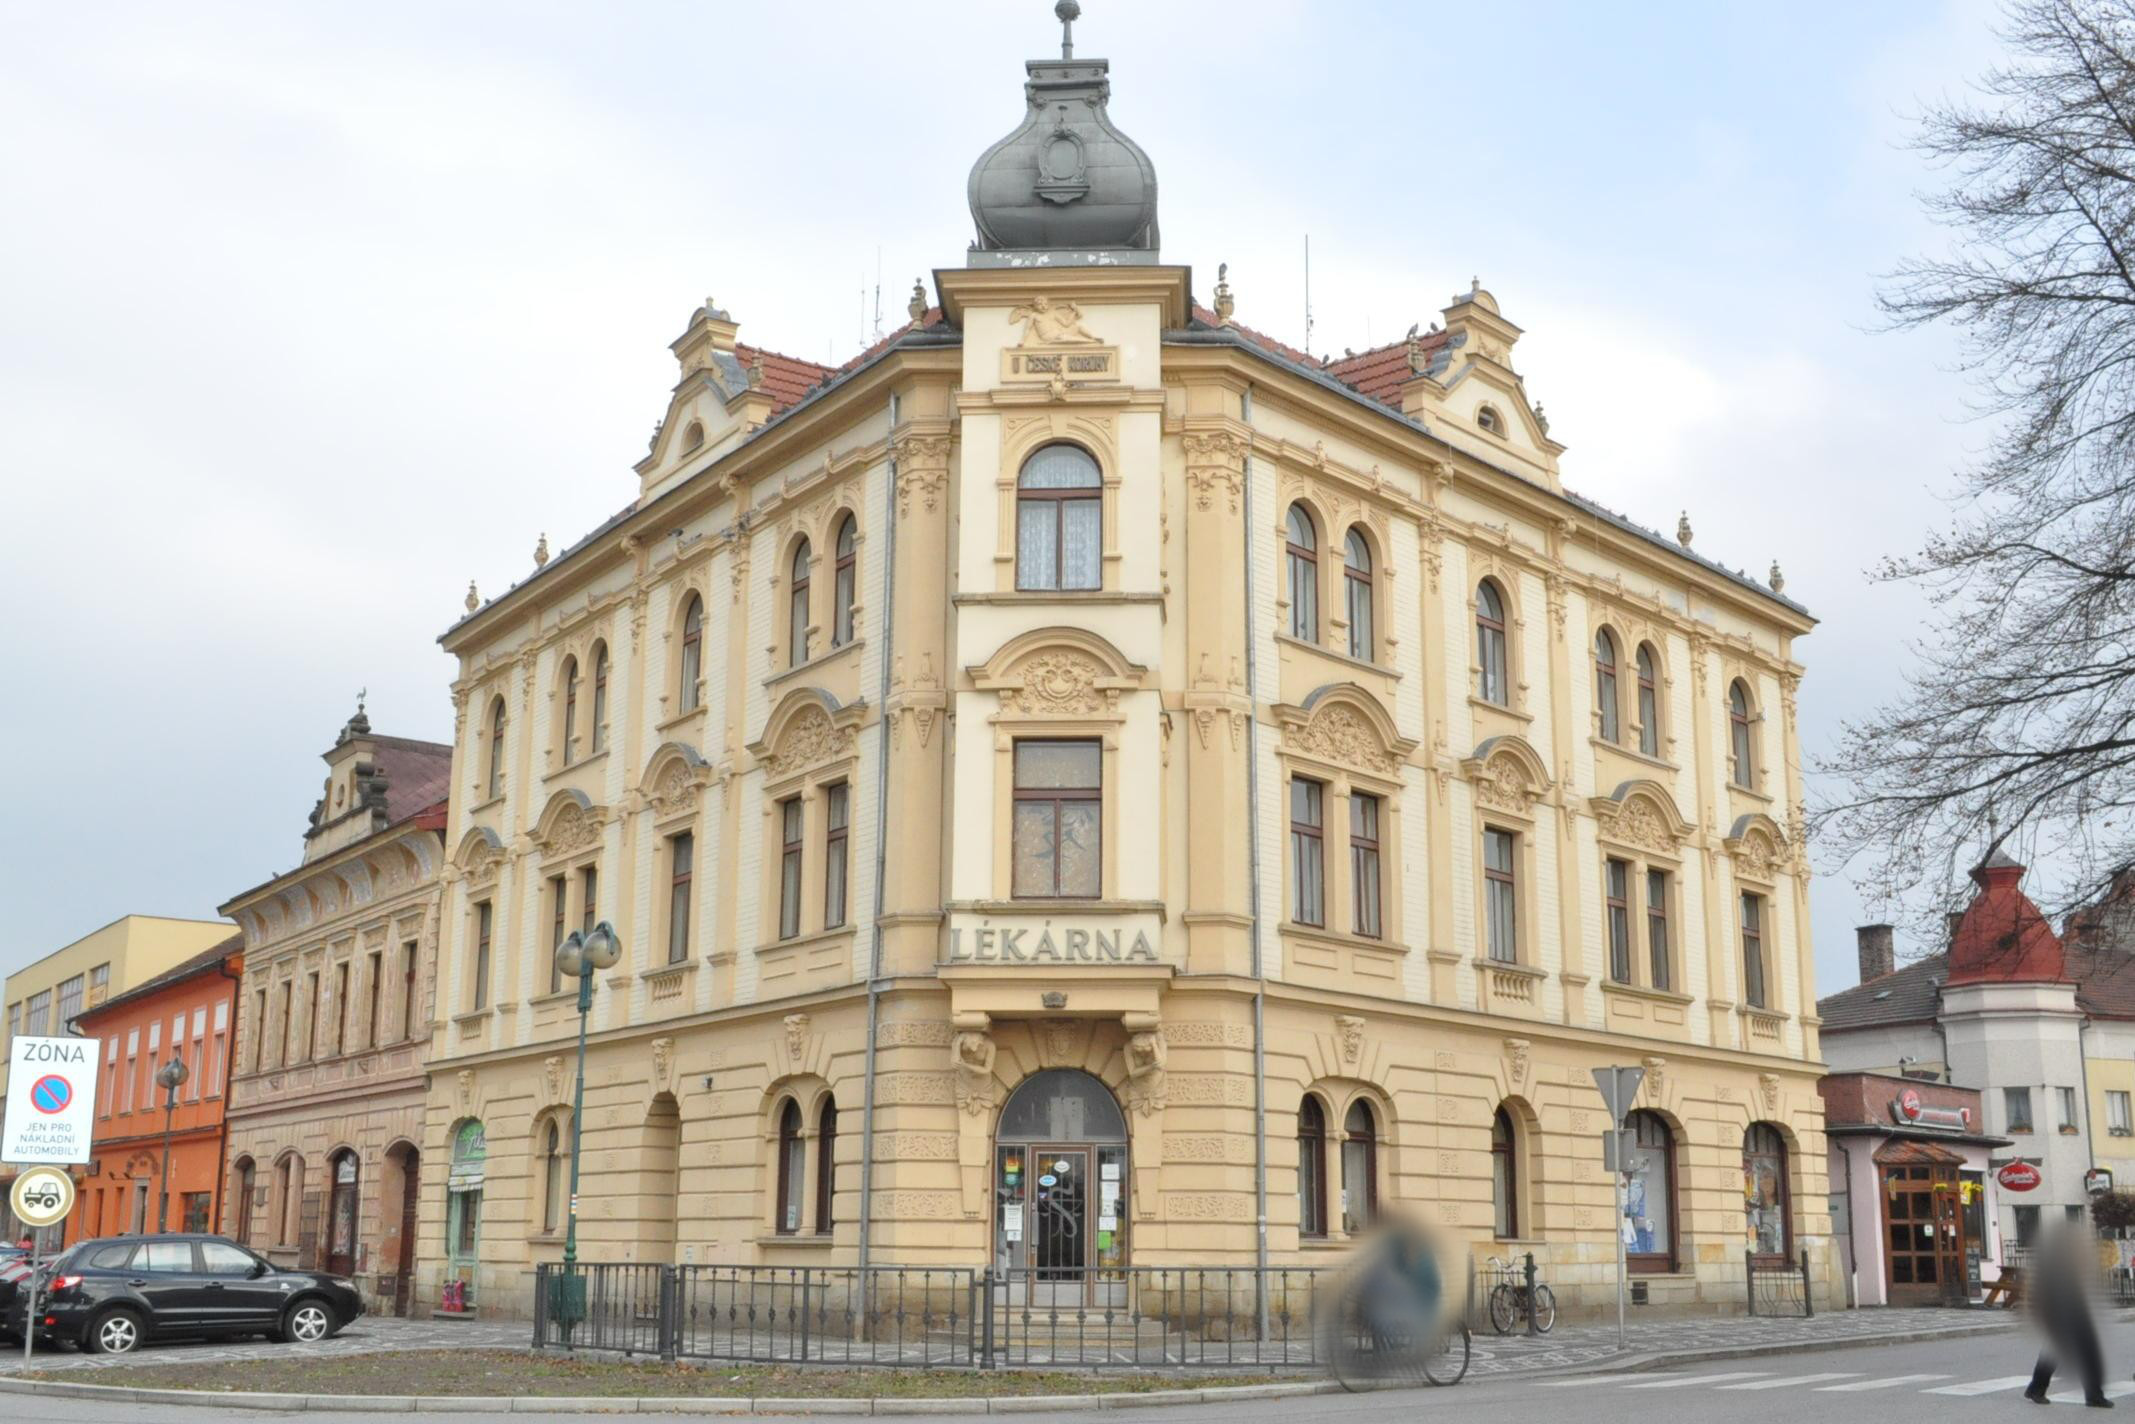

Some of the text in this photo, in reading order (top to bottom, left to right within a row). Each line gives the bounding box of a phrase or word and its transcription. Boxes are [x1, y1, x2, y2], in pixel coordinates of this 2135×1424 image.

[951, 920, 1158, 961] LÉKÁRNA
[24, 1040, 85, 1063] ZÓNA
[26, 1122, 72, 1132] JEN PRO
[20, 1132, 76, 1144] NÁKLADNÍ
[14, 1145, 79, 1156] AUTOMOBILY
